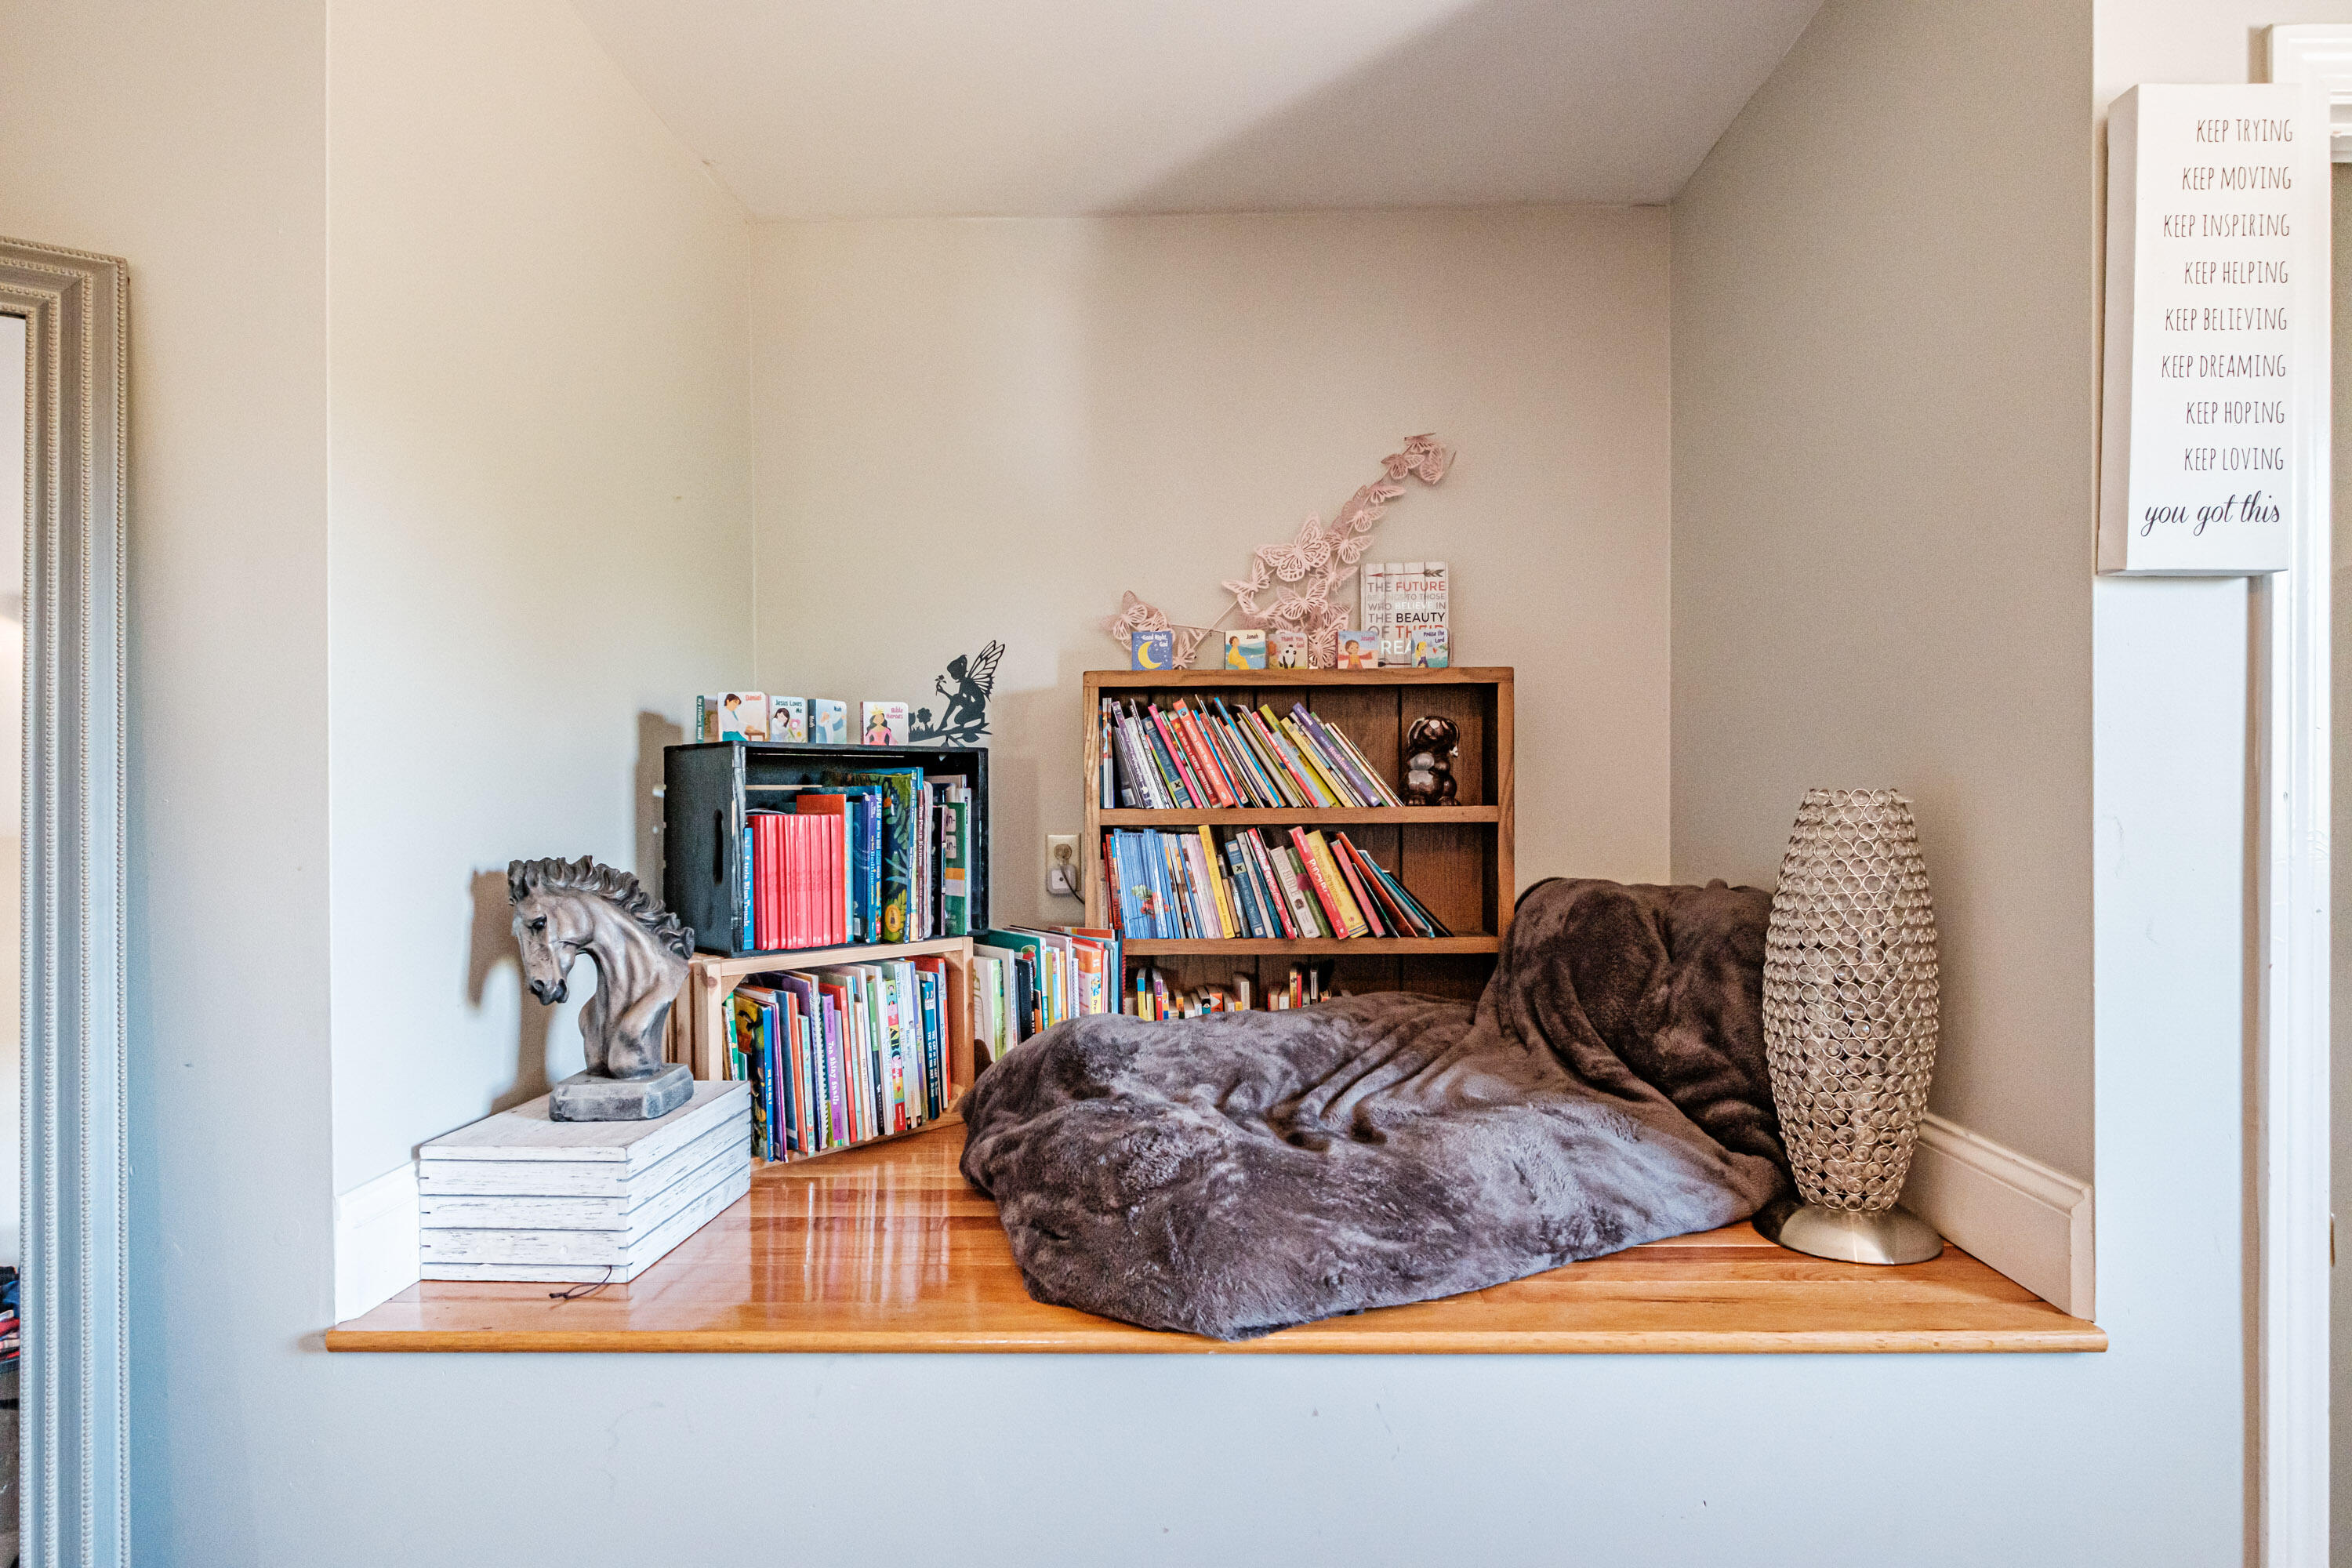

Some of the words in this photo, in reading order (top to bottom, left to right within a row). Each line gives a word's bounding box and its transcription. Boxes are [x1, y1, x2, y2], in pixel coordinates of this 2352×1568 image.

[2196, 119, 2229, 142] KEEP
[2235, 118, 2293, 143] TRYING
[2182, 167, 2215, 191] KEEP
[2220, 166, 2292, 191] MOVING
[2163, 214, 2196, 238] KEEP
[2202, 213, 2290, 238] INSPIRING
[2184, 261, 2216, 284] KEEP
[2223, 260, 2288, 285] HELPING
[2165, 307, 2198, 331] KEEP
[2203, 307, 2288, 332] BELIEVING
[2161, 354, 2194, 379] KEEP
[2199, 354, 2286, 379] DREAMING
[2186, 401, 2219, 424] KEEP
[2224, 401, 2285, 425] HOPING
[2184, 448, 2216, 470] KEEP
[2222, 447, 2284, 471] LOVING
[2141, 506, 2189, 537] you
[2194, 494, 2239, 536] got
[2240, 490, 2281, 524] this
[1367, 583, 1392, 592] THE
[1396, 581, 1446, 592] FUTURE
[1368, 613, 1392, 622] THE
[1396, 612, 1445, 622] BEAUTY
[1395, 601, 1432, 610] BELIEVE
[1327, 745, 1351, 771] Bedtime
[1281, 869, 1301, 897] BIBLE
[889, 1027, 900, 1060] ABC
[827, 1057, 837, 1078] Shiny
